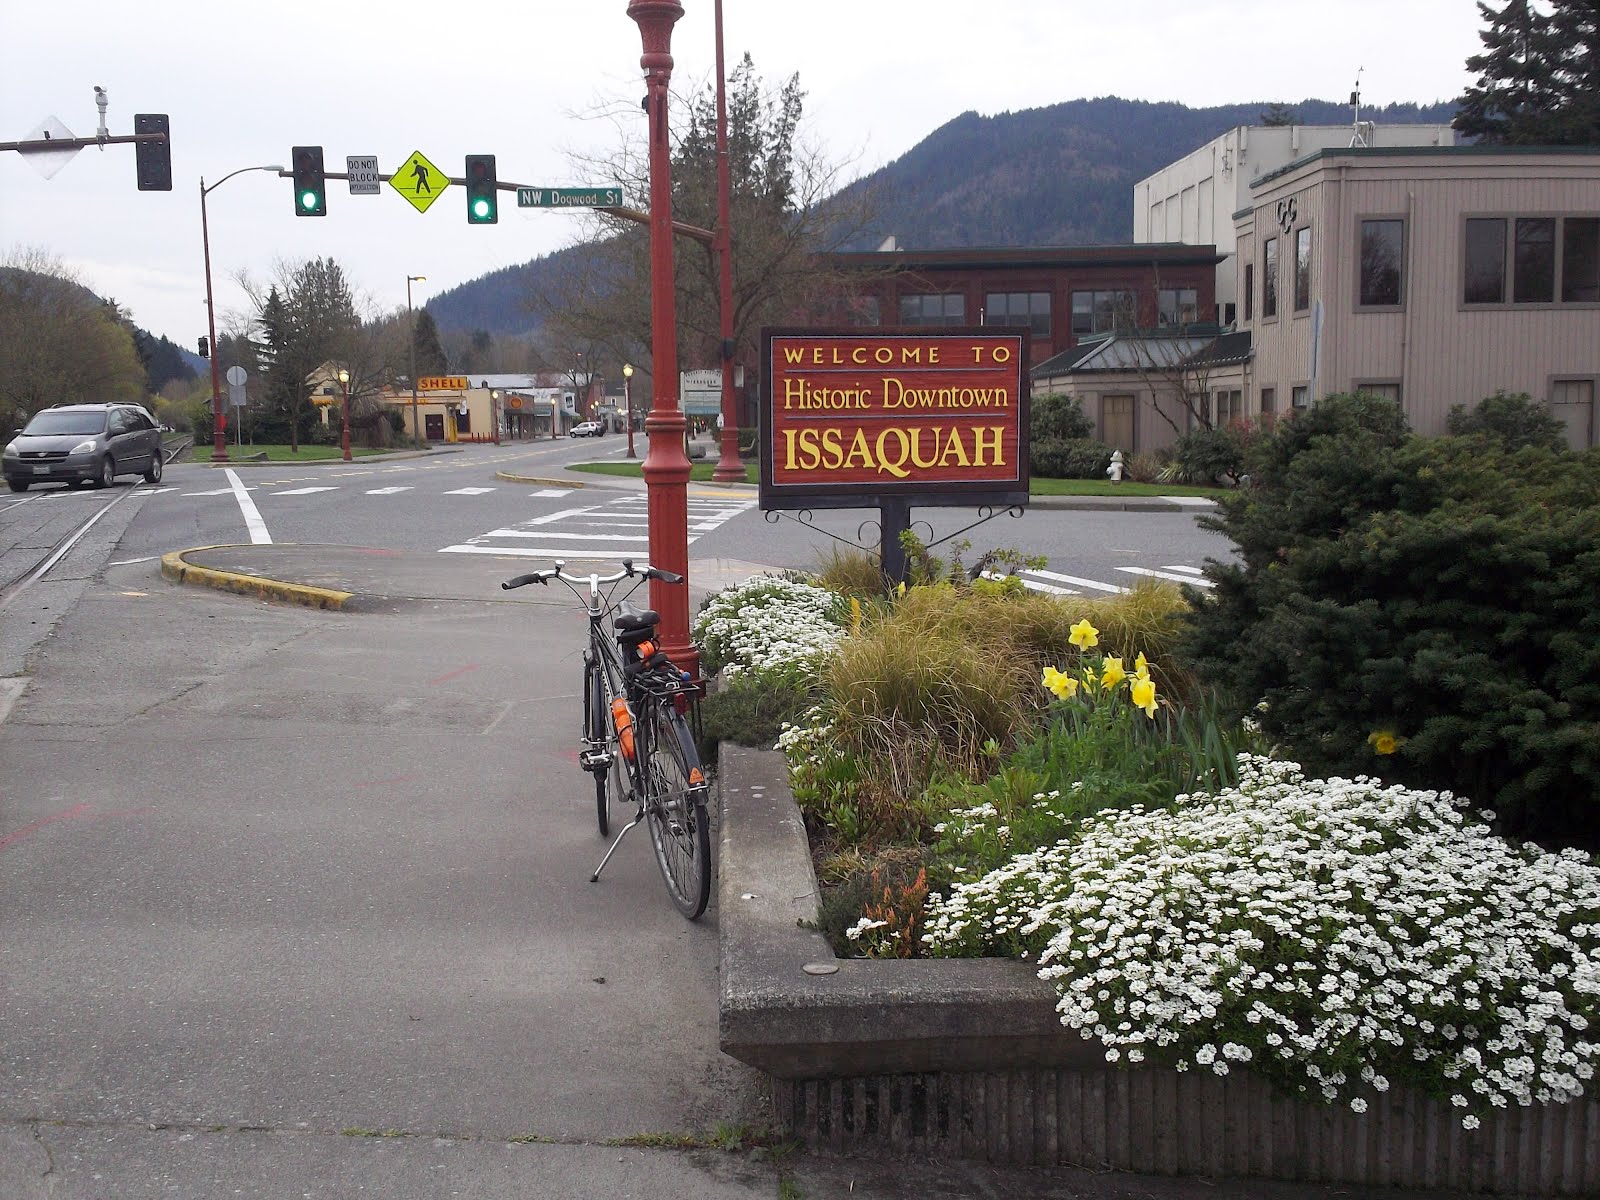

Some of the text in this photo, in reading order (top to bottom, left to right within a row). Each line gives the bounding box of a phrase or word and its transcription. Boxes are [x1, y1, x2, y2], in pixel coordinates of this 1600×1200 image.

[349, 160, 376, 170] DO NOT
[350, 173, 378, 182] BLOCK
[522, 190, 618, 206] NW Dogwood St
[783, 346, 1011, 364] WELCOME TO
[421, 379, 464, 388] SHELL
[783, 377, 1009, 410] Historic Downtown
[782, 426, 1007, 478] ISSAQUAH
